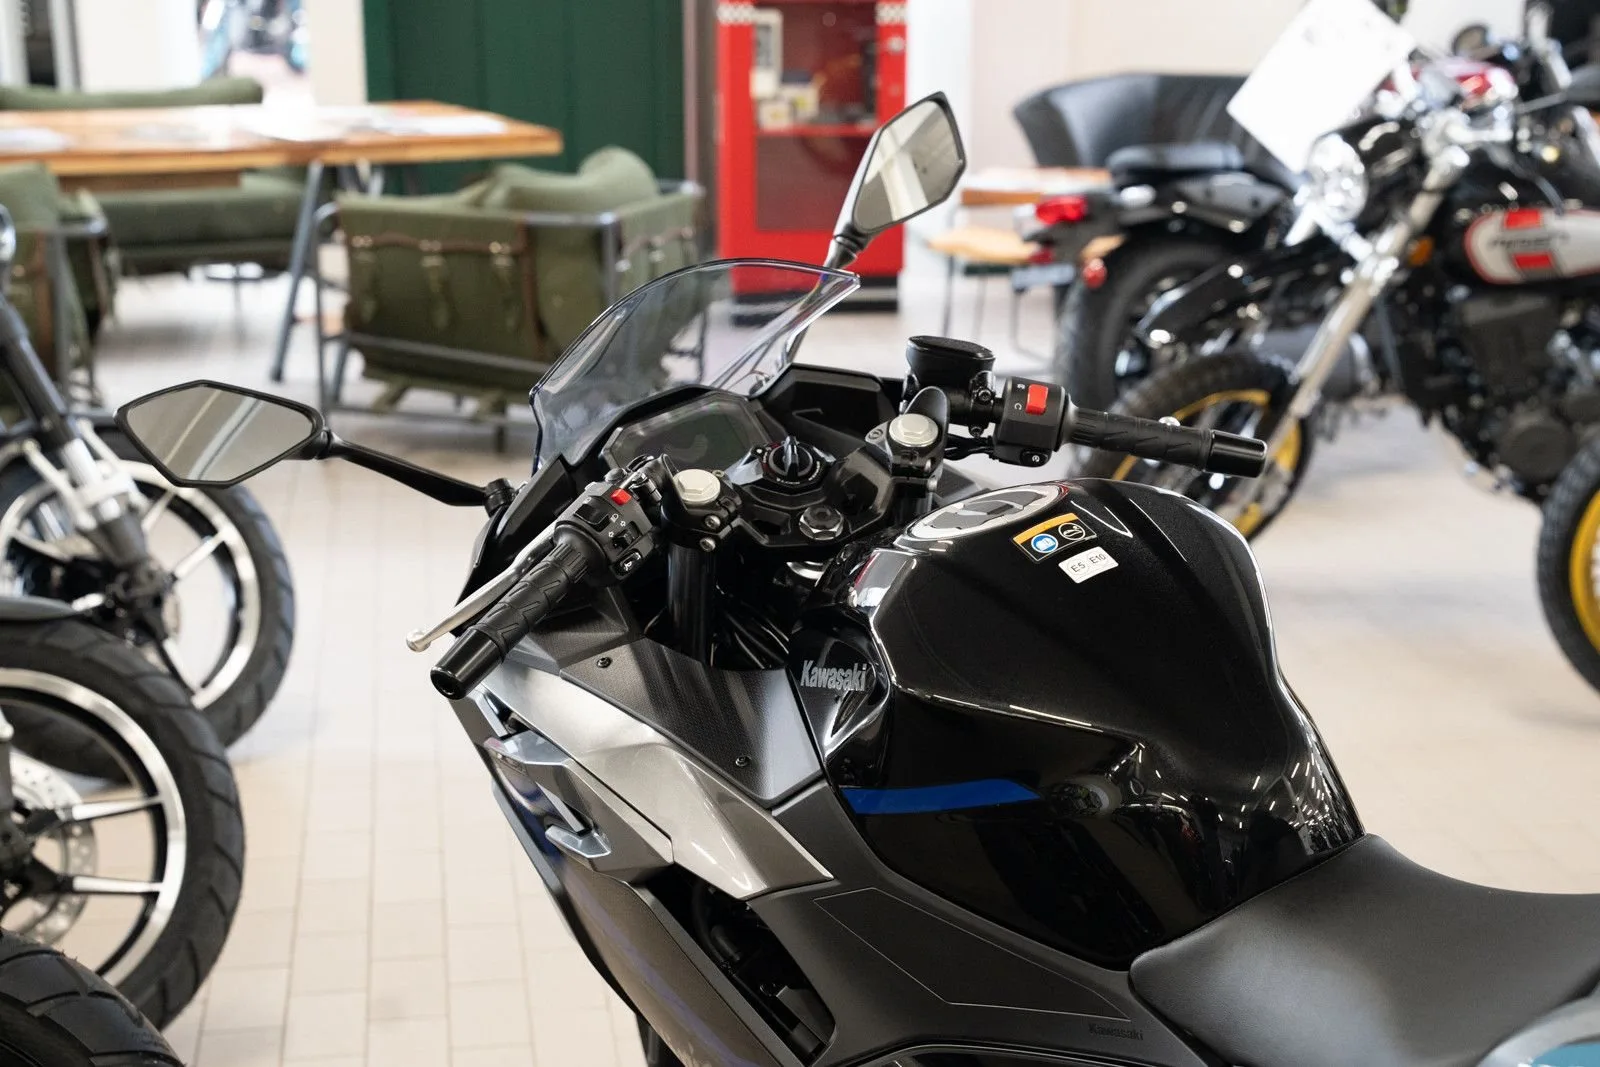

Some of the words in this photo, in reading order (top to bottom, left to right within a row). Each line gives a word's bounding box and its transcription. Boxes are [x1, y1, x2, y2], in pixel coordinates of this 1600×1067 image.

[1071, 561, 1086, 573] E5
[1089, 554, 1106, 564] E10
[800, 660, 868, 691] Kawasaki
[1088, 1023, 1144, 1041] Kawasaki
